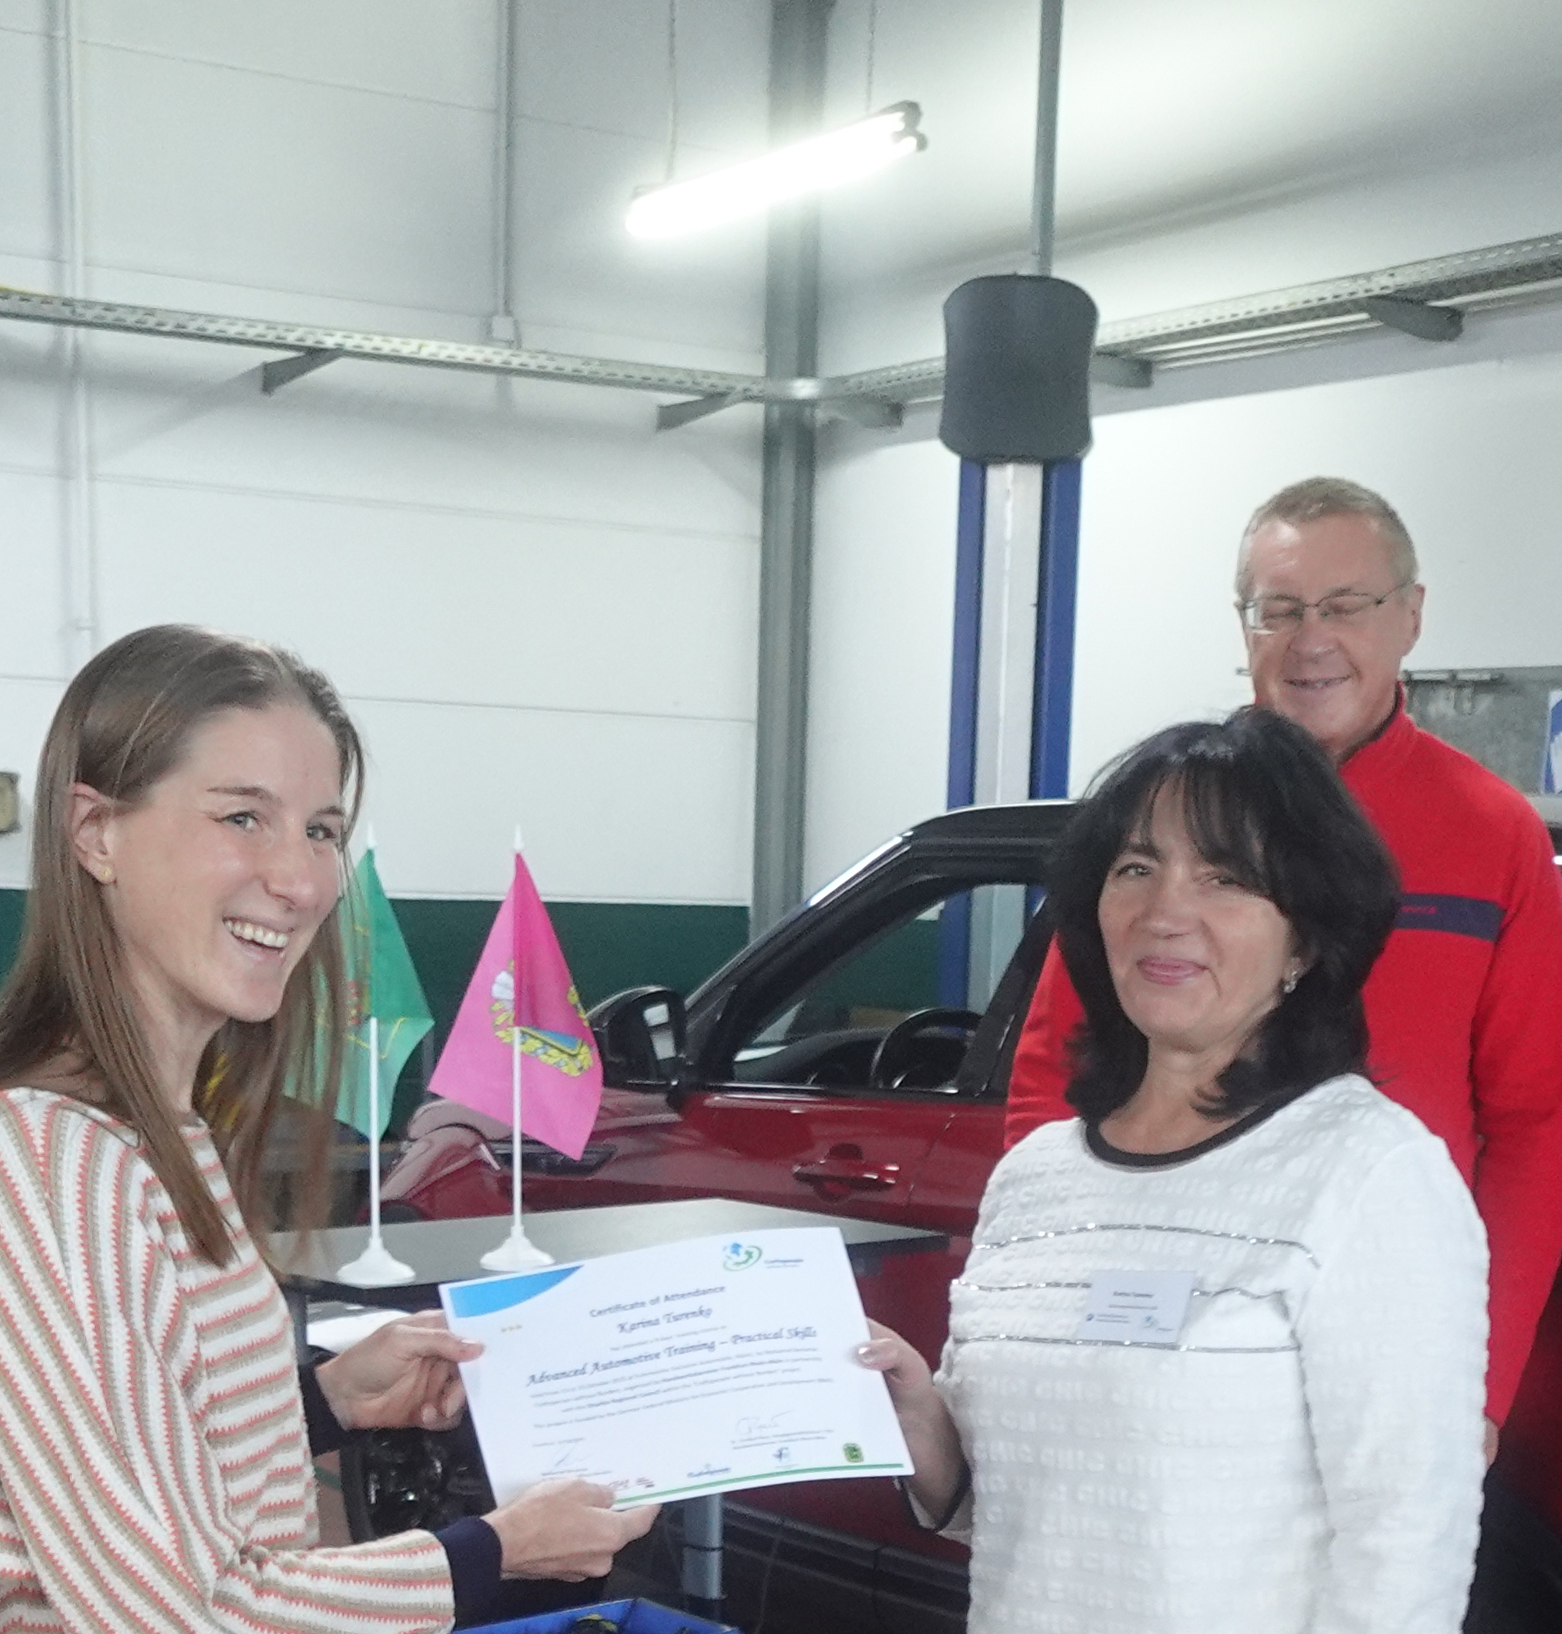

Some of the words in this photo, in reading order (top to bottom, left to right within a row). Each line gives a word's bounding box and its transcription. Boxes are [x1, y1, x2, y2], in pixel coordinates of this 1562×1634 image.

[590, 1299, 647, 1318] Certificate
[663, 1285, 727, 1303] Attendance
[527, 1362, 588, 1387] Advanced
[590, 1351, 662, 1374] Automotive
[663, 1340, 716, 1358] Training
[731, 1328, 785, 1345] Practical
